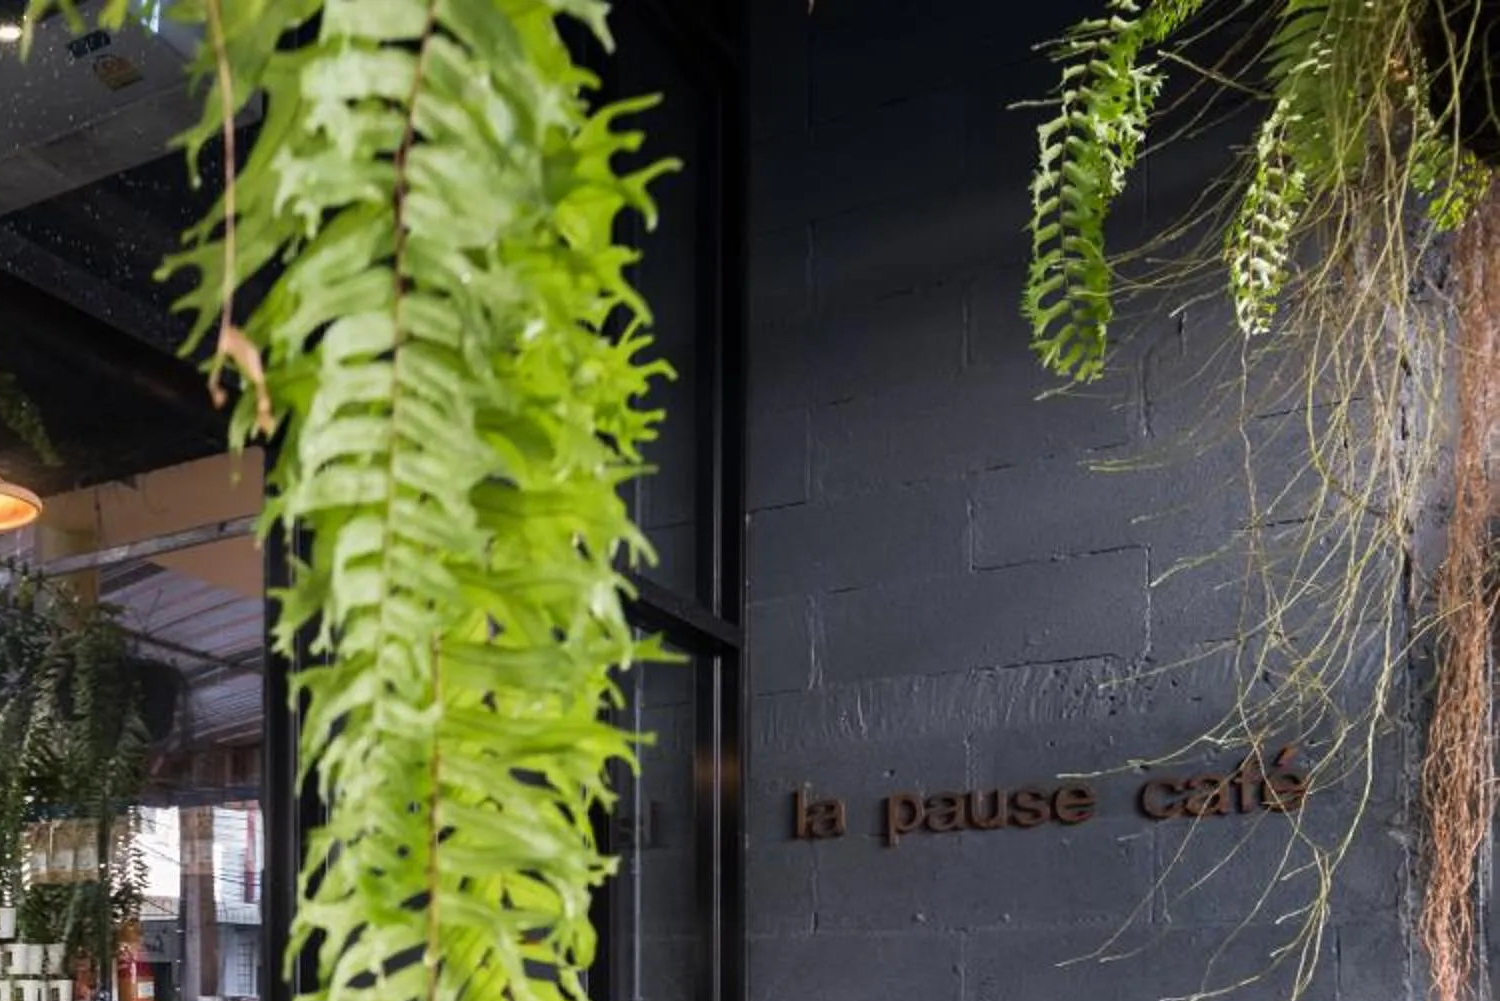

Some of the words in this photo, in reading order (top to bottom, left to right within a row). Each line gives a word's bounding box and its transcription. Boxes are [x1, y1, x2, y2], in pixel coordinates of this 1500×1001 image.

[792, 789, 847, 840] la
[881, 783, 1097, 848] pause
[1134, 745, 1310, 822] café
